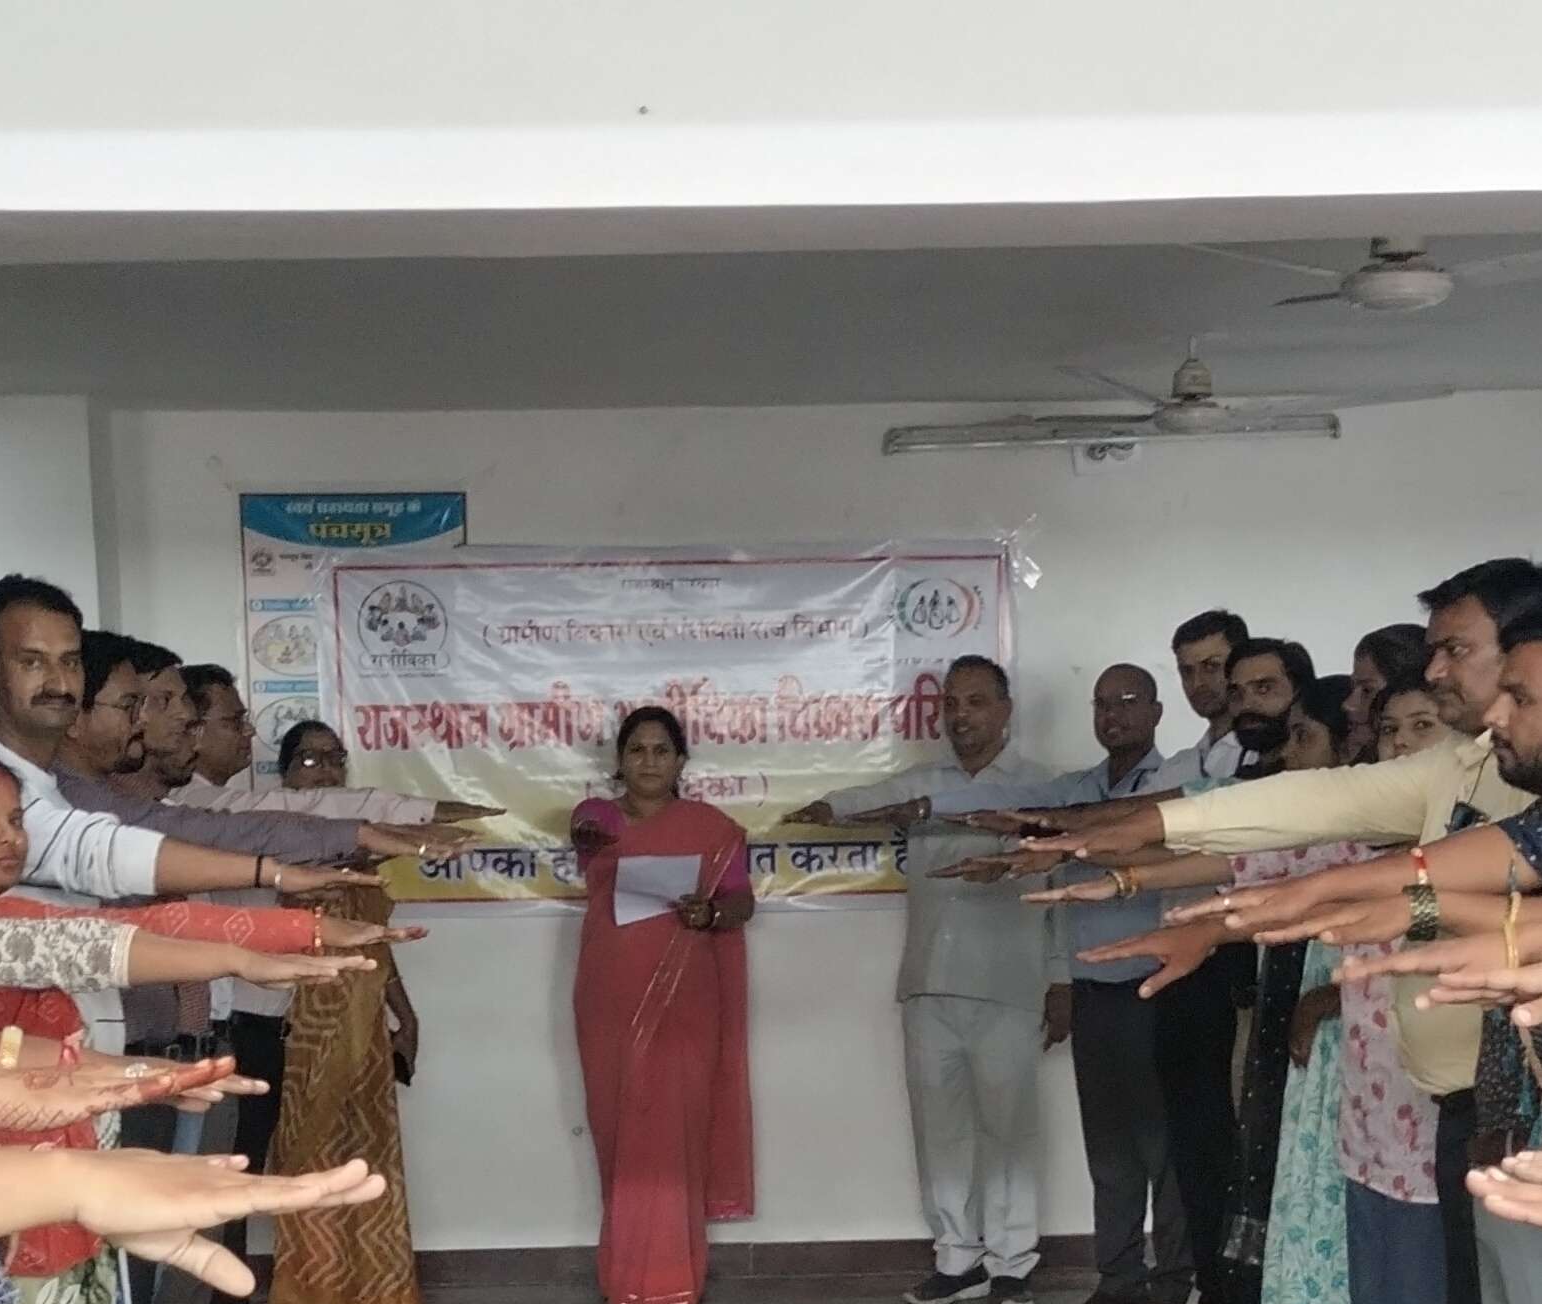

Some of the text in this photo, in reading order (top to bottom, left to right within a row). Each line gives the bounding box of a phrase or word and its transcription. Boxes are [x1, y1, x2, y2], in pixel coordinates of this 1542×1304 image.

[310, 516, 392, 546] पंचसूत्र
[500, 619, 560, 644] ग्रामीण
[355, 701, 490, 751] राजस्थान
[497, 681, 607, 751] ग्रामीण
[772, 675, 883, 743] विकास
[889, 671, 945, 742] परि
[418, 847, 542, 881] आपका
[786, 840, 883, 874] करता
